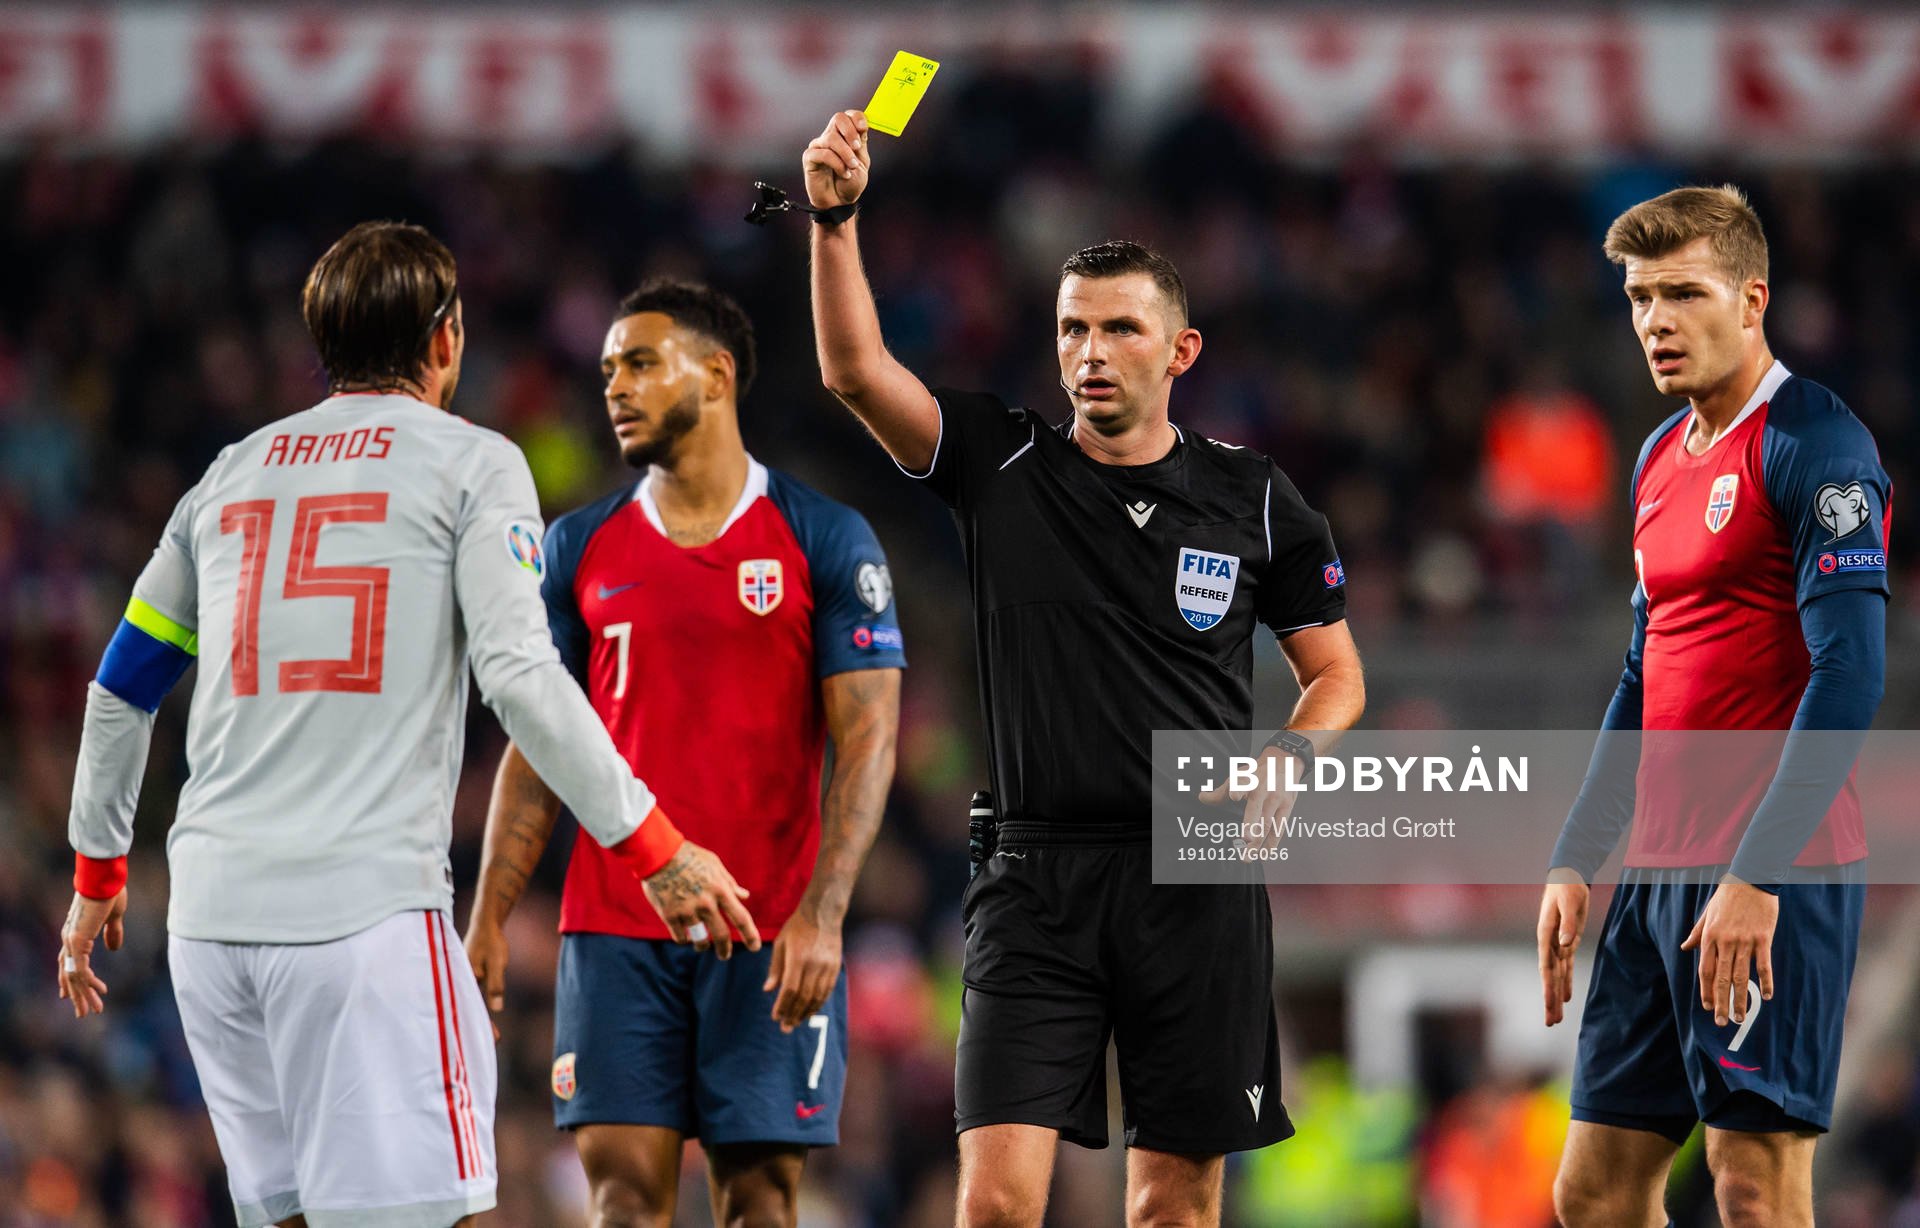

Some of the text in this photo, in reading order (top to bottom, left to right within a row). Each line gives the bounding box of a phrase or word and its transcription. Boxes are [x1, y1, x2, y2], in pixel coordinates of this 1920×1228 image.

[1183, 553, 1231, 579] FIFA
[1838, 554, 1886, 567] RESPEC
[220, 492, 390, 697] 15
[1180, 584, 1228, 602] REFEREE
[1190, 612, 1213, 625] 2019
[603, 621, 632, 700] 7
[1727, 979, 1762, 1053] 9
[808, 1014, 829, 1089] 7
